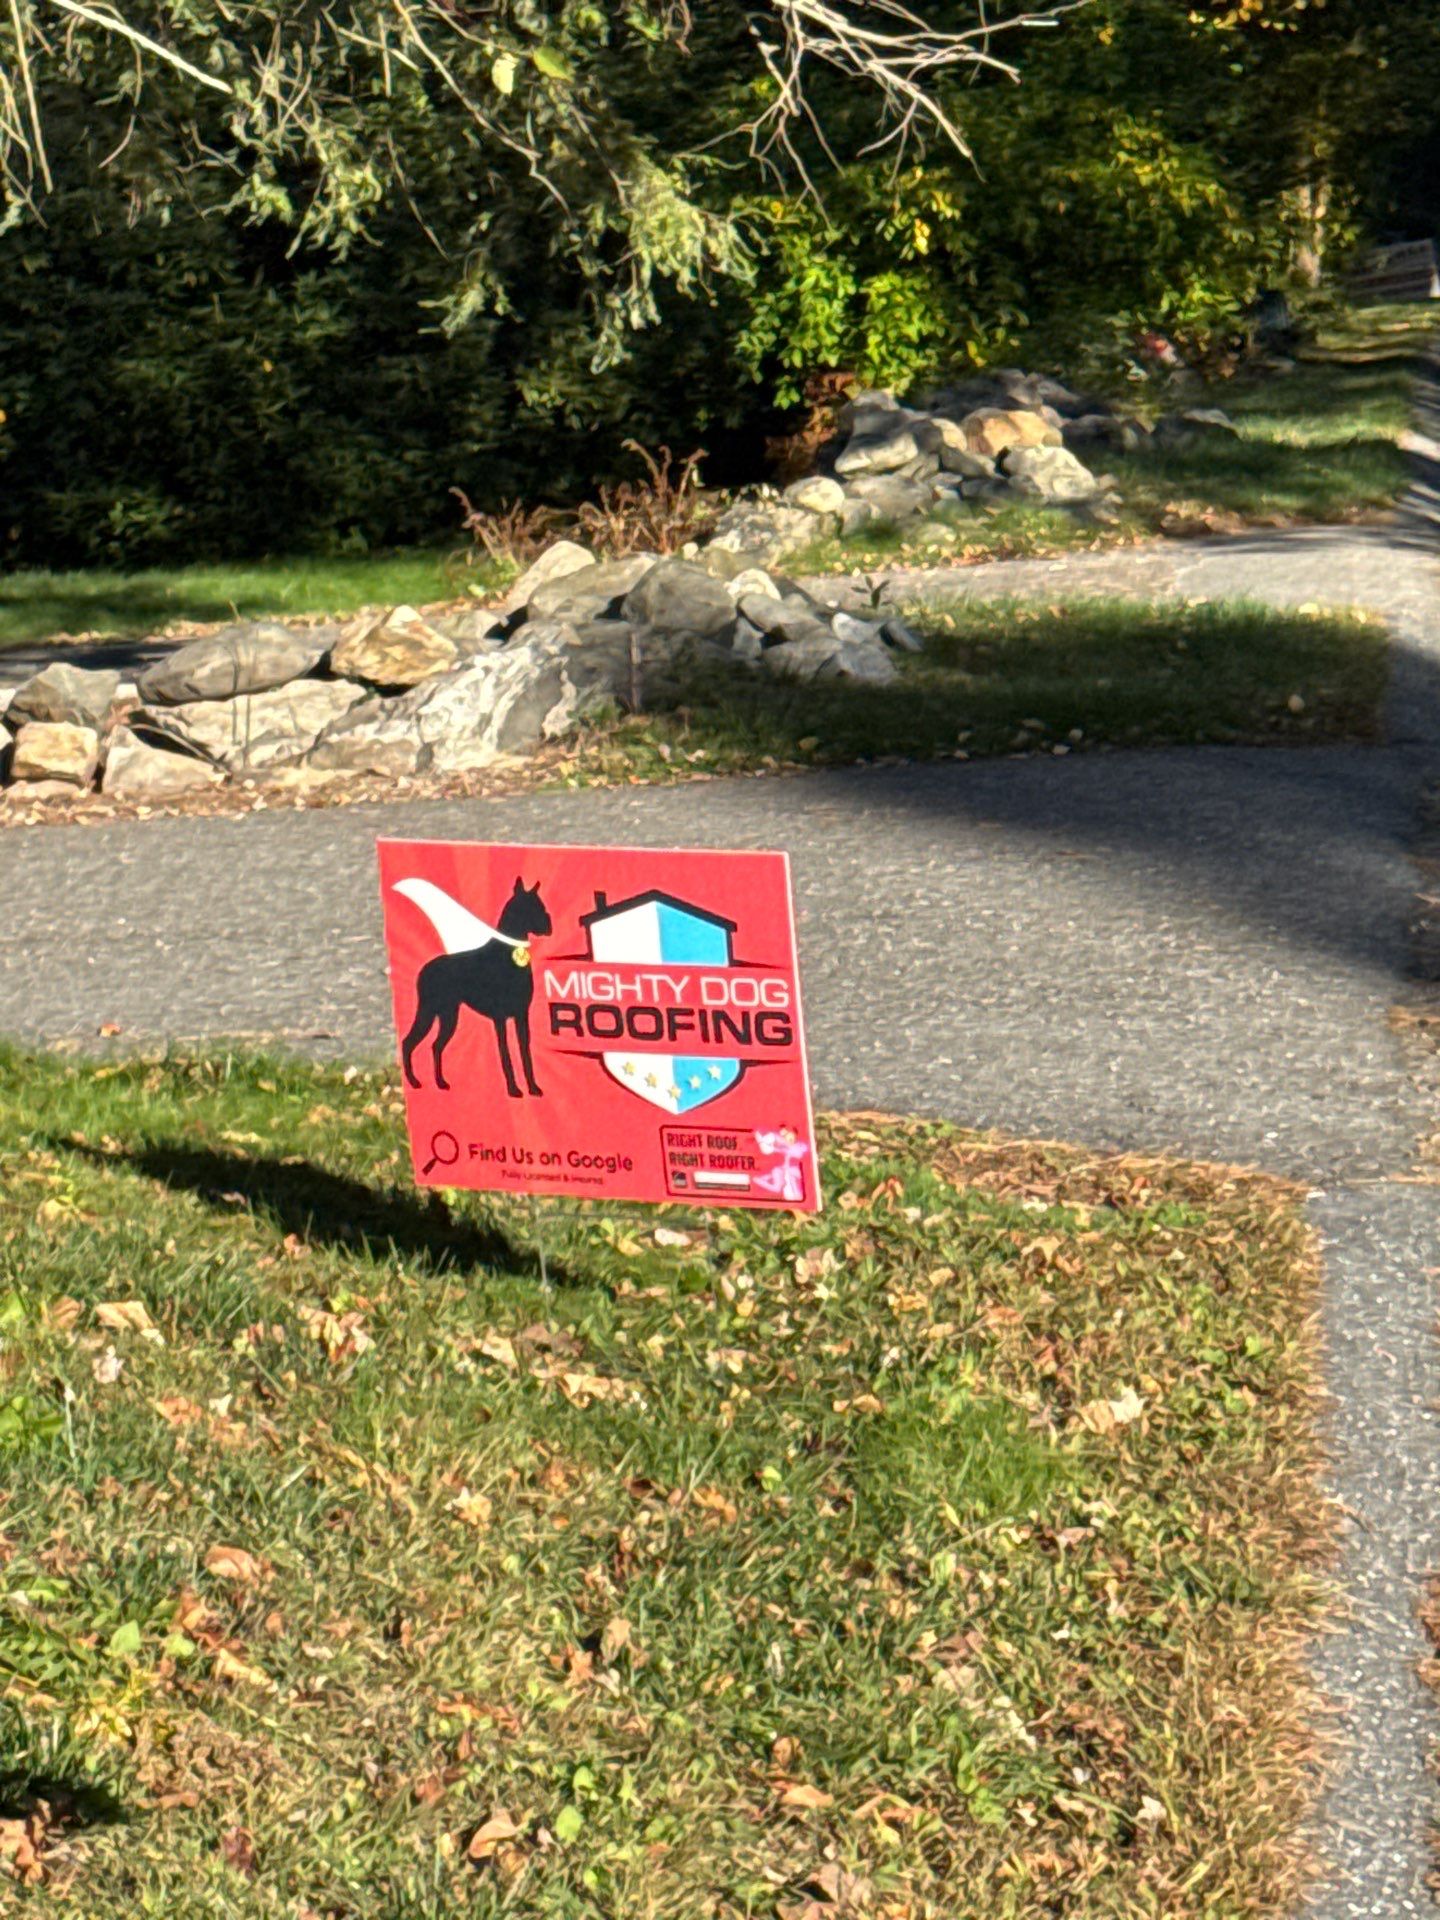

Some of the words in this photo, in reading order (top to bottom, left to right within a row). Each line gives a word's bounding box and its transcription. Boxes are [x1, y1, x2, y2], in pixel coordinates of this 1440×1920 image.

[544, 969, 690, 1003] MIGHTY
[700, 976, 789, 1008] DOG
[548, 1002, 793, 1046] ROOFING
[667, 1133, 703, 1148] RIGHT
[468, 1143, 507, 1163] Find
[512, 1147, 534, 1165] Us
[539, 1151, 562, 1166] on
[567, 1150, 633, 1173] Google
